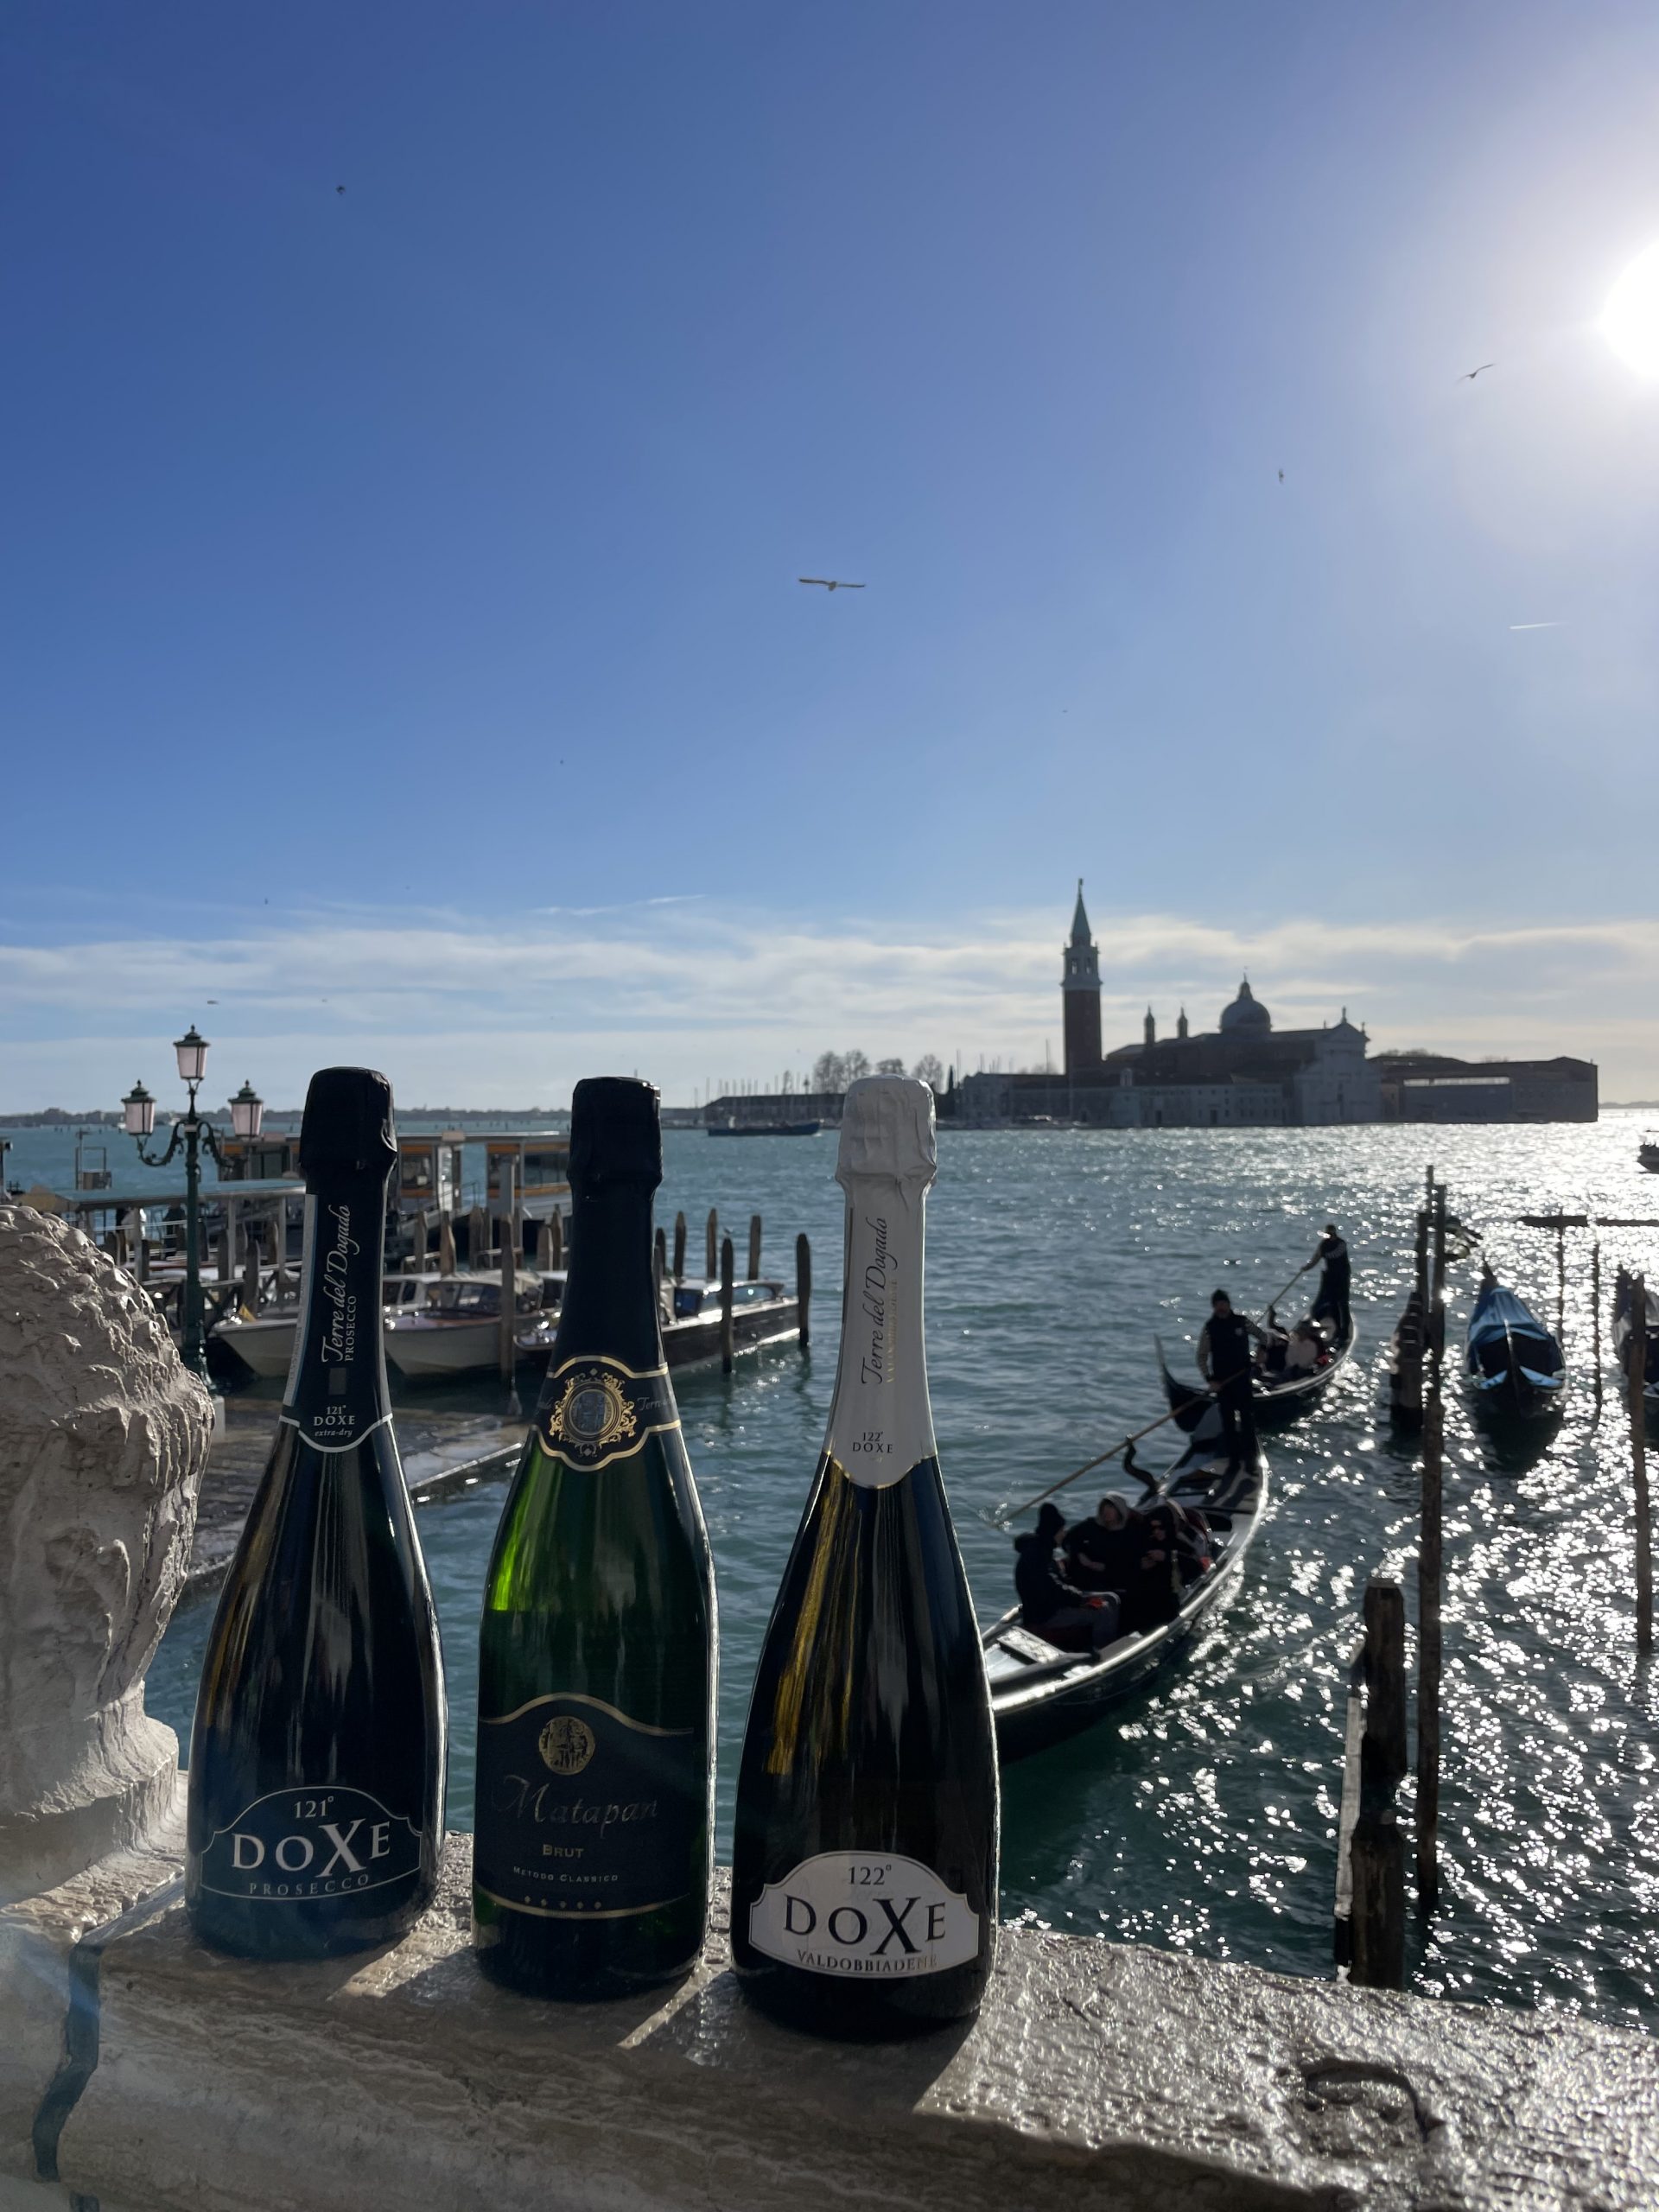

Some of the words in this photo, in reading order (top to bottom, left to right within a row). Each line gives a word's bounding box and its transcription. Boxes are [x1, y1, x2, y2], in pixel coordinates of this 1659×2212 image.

[327, 1204, 360, 1275] Dogado
[866, 1216, 899, 1291] Dogado
[323, 1271, 346, 1309] del
[862, 1291, 886, 1328] del
[321, 1308, 345, 1363] Terre
[345, 1295, 357, 1362] PROSECCO
[861, 1329, 884, 1384] Terre
[314, 1415, 356, 1426] DOXE
[315, 1428, 353, 1438] extra-dry
[852, 1441, 893, 1453] DOXE
[294, 1796, 335, 1819] 121°
[492, 1774, 658, 1840] Matapan
[231, 1818, 391, 1878] DOXE
[249, 1873, 370, 1897] PROSECCO
[848, 1863, 893, 1886] 122°
[783, 1893, 947, 1956] DOXE
